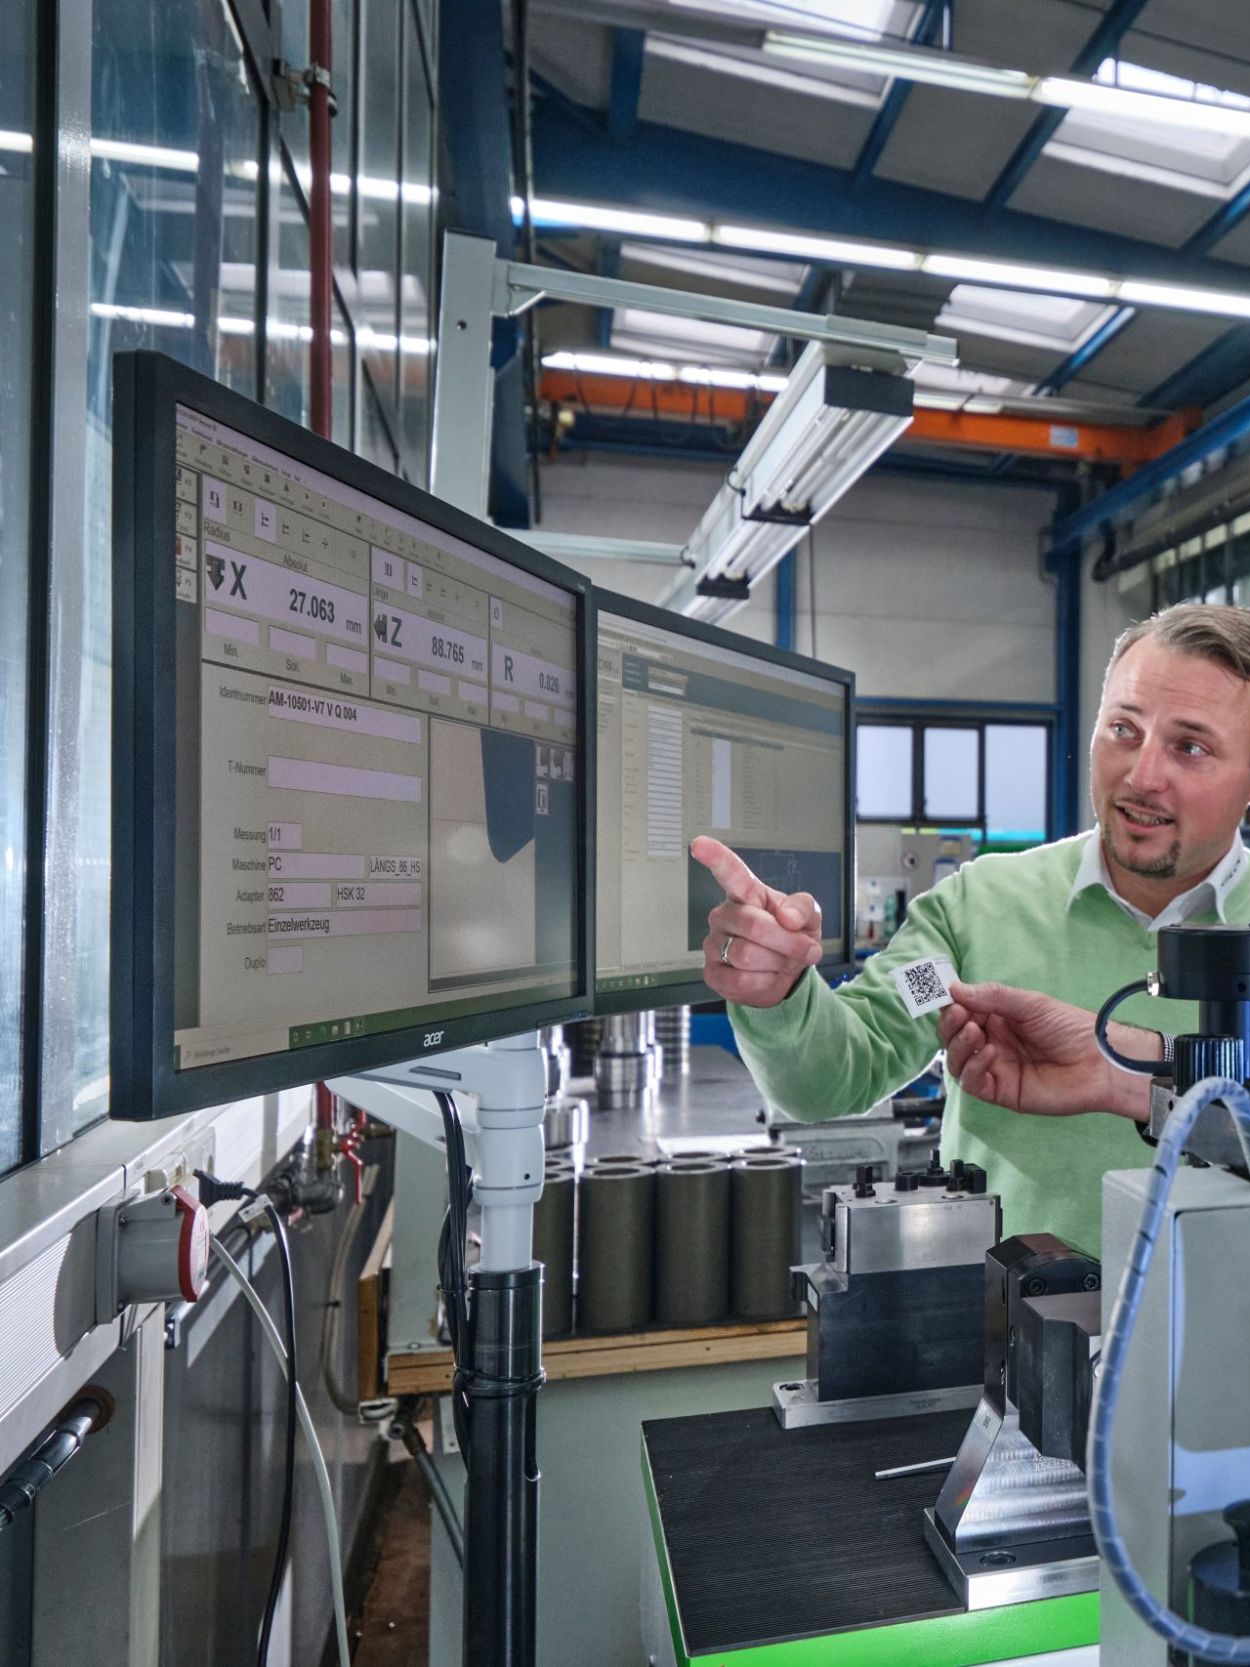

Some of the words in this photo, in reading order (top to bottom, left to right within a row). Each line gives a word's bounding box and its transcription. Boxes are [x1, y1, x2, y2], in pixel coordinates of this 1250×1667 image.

[204, 521, 231, 542] Radius
[230, 561, 247, 600] X
[289, 588, 335, 623] 27.063
[346, 619, 362, 634] mm
[390, 616, 402, 648] Z
[432, 636, 464, 664] 88.765
[504, 655, 514, 683] R
[268, 690, 325, 716] AM-10501-V7
[335, 704, 342, 719] Q
[343, 707, 357, 721] 004
[228, 760, 266, 777] T-Nummer
[234, 826, 266, 844] Messung
[269, 827, 281, 842] 1/1
[232, 858, 266, 872] Maschine
[268, 857, 282, 871] PC
[268, 887, 285, 902] 862
[337, 886, 355, 901] HSK
[356, 887, 365, 901] 32
[227, 920, 266, 936] Betriebsart
[268, 917, 330, 934] Einzelwerkzeug
[244, 955, 266, 970] Duplo
[424, 1031, 445, 1047] acer
